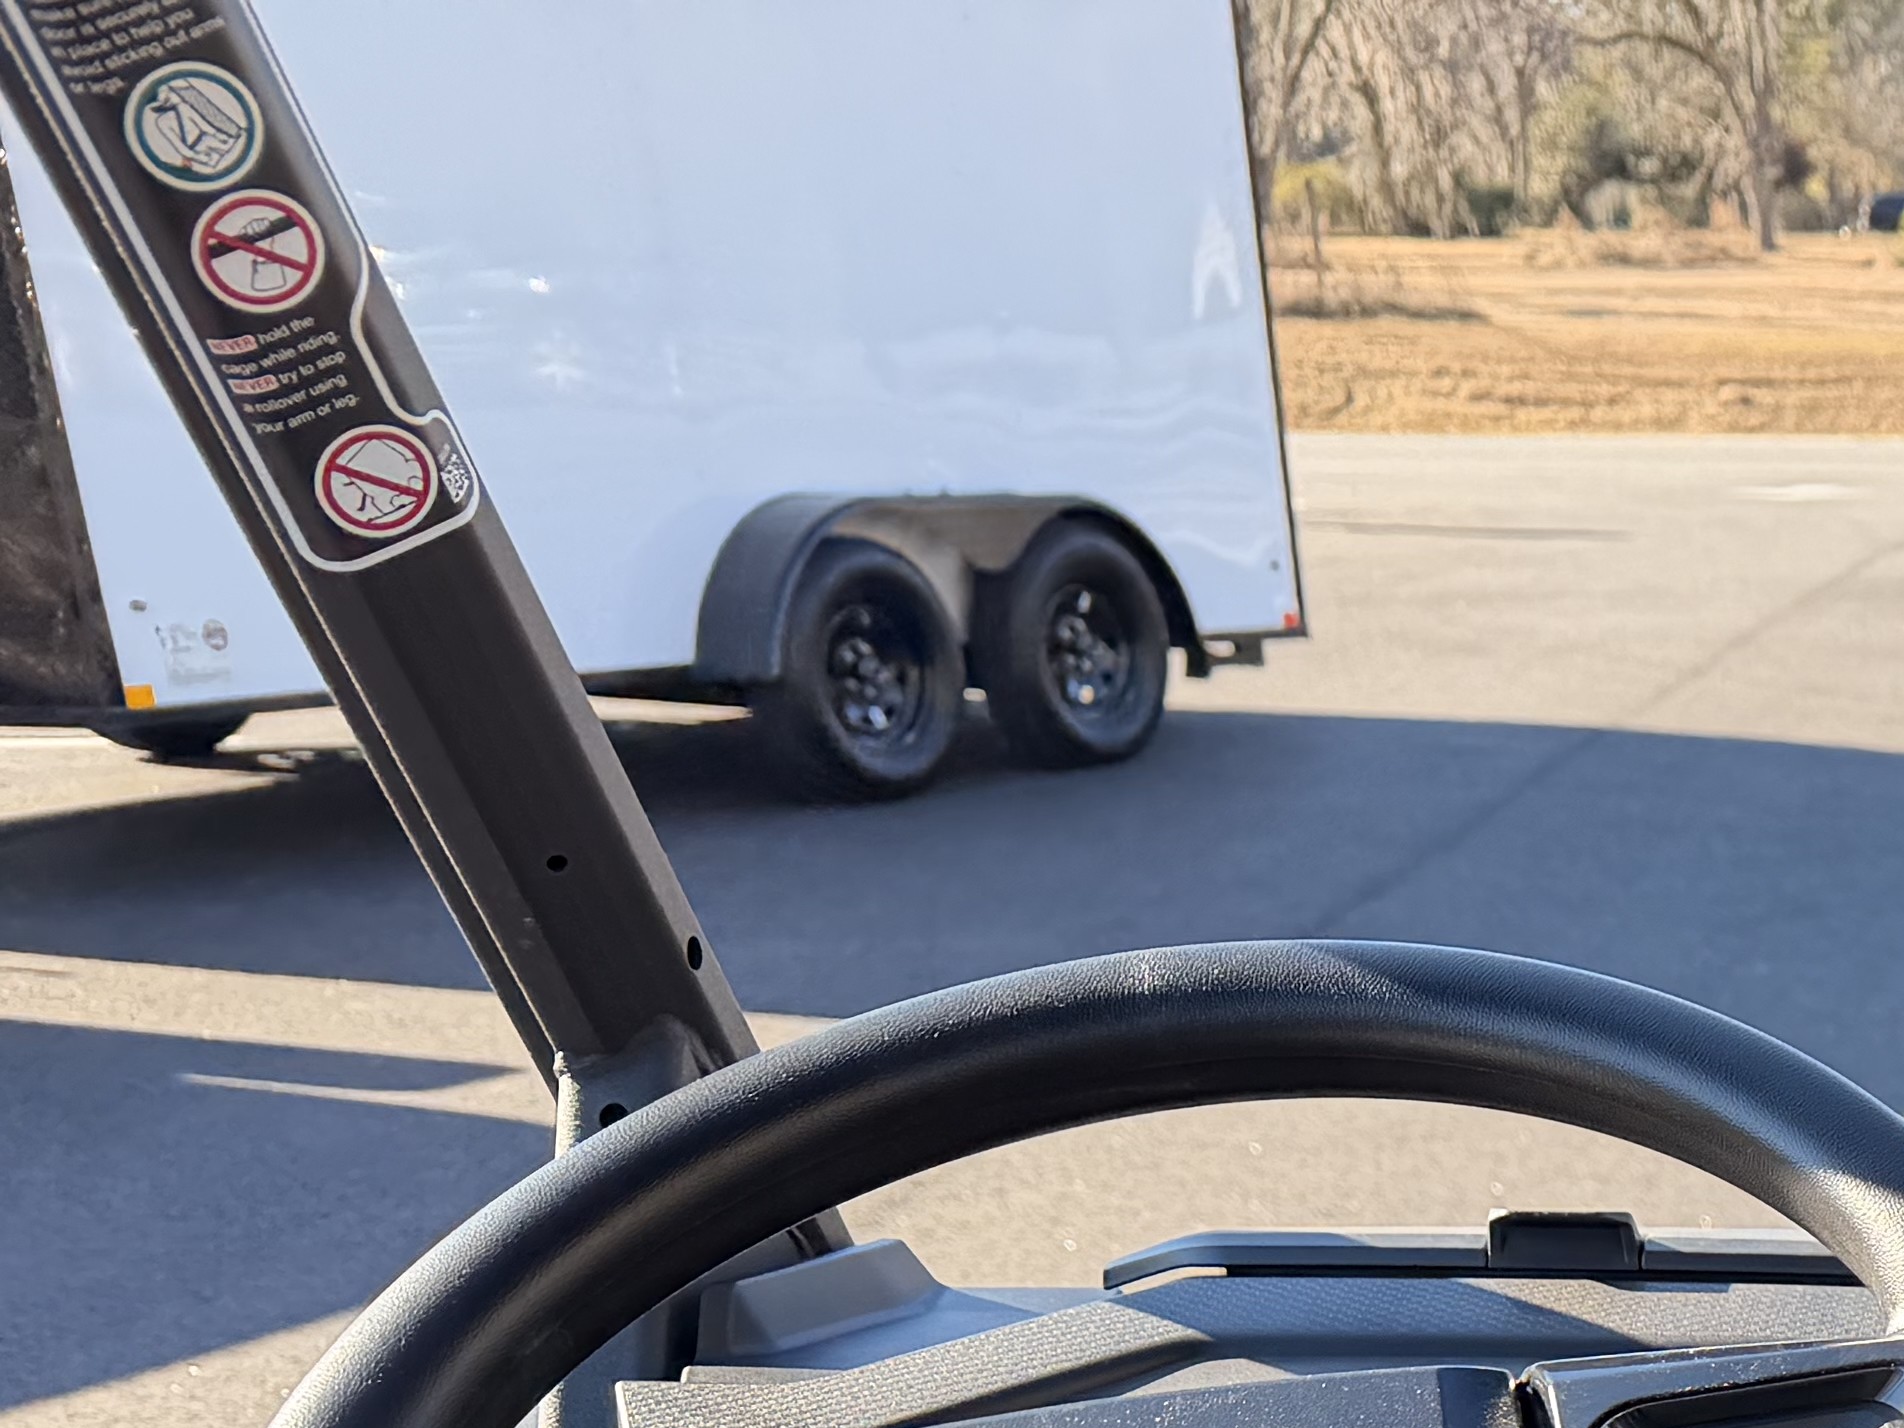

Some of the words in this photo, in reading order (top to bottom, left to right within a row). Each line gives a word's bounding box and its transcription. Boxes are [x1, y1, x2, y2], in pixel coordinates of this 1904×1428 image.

[164, 8, 195, 29] you
[257, 325, 290, 345] hold
[289, 316, 315, 333] the
[259, 347, 297, 369] while
[278, 369, 299, 384] try
[299, 364, 315, 377] to
[315, 351, 347, 370] stop
[255, 389, 308, 413] rollover
[308, 374, 348, 396] using
[252, 420, 285, 435] your
[286, 410, 316, 428] arm
[316, 402, 331, 416] or
